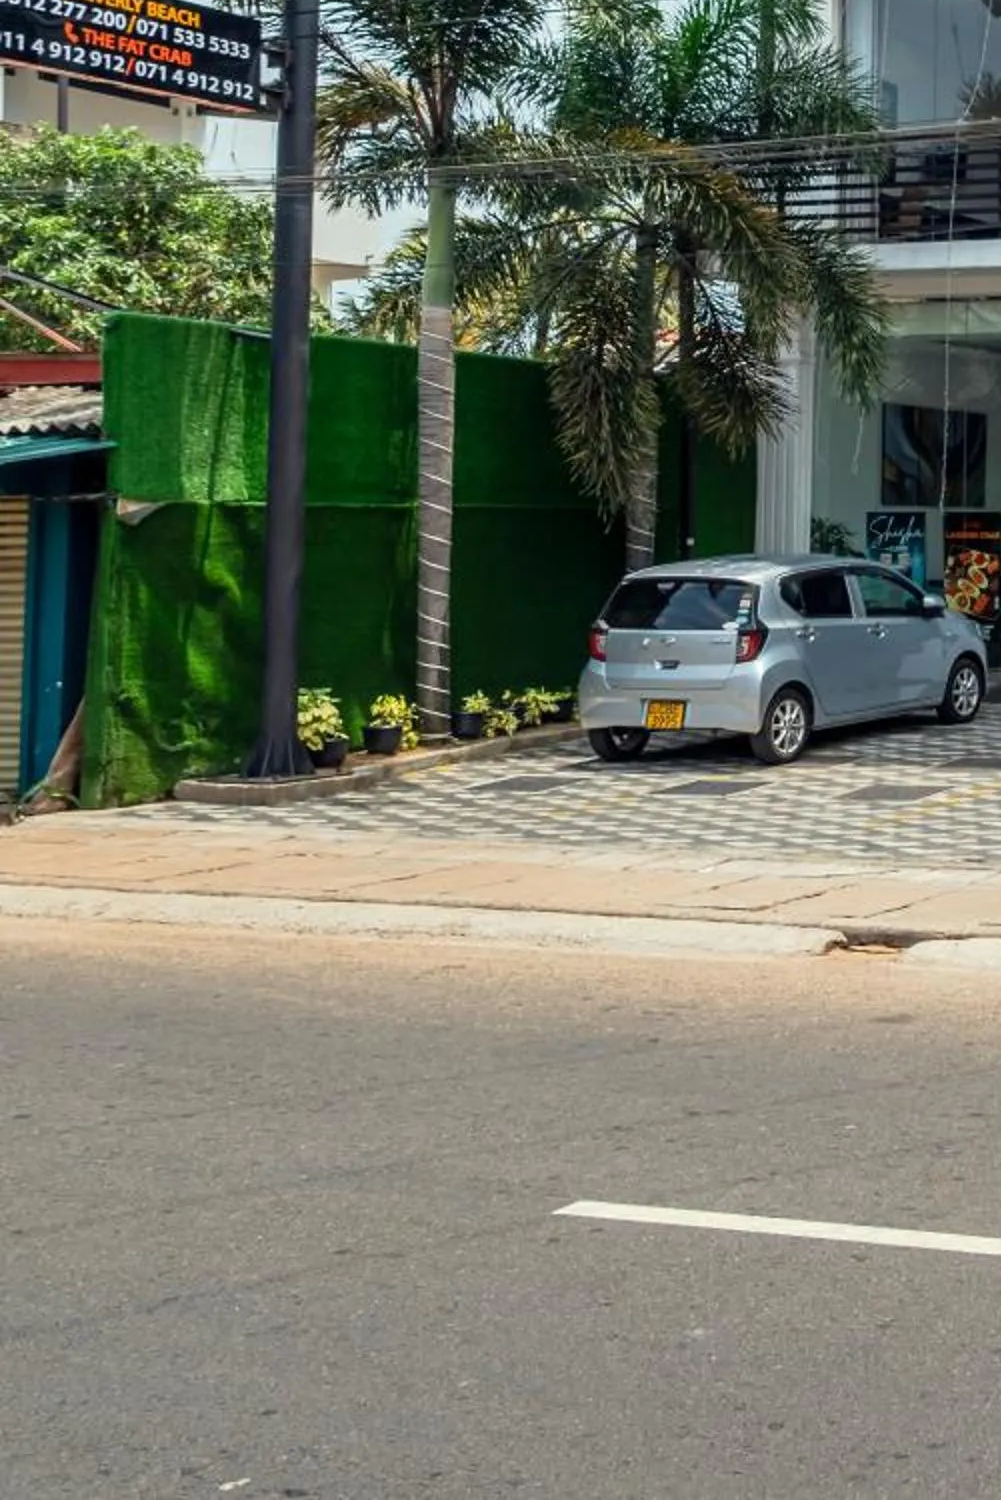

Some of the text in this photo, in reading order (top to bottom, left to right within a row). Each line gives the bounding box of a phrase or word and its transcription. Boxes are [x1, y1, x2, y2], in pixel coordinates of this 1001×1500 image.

[147, 1, 200, 28] BEACH
[82, 27, 193, 68] THE FAT CRAB
[173, 27, 205, 49] 533
[208, 35, 250, 59] 5333
[0, 30, 25, 51] 11
[30, 38, 45, 56] 4
[48, 41, 86, 65] 912
[171, 69, 185, 86] 4
[187, 71, 219, 93] 912
[222, 80, 254, 101] 912
